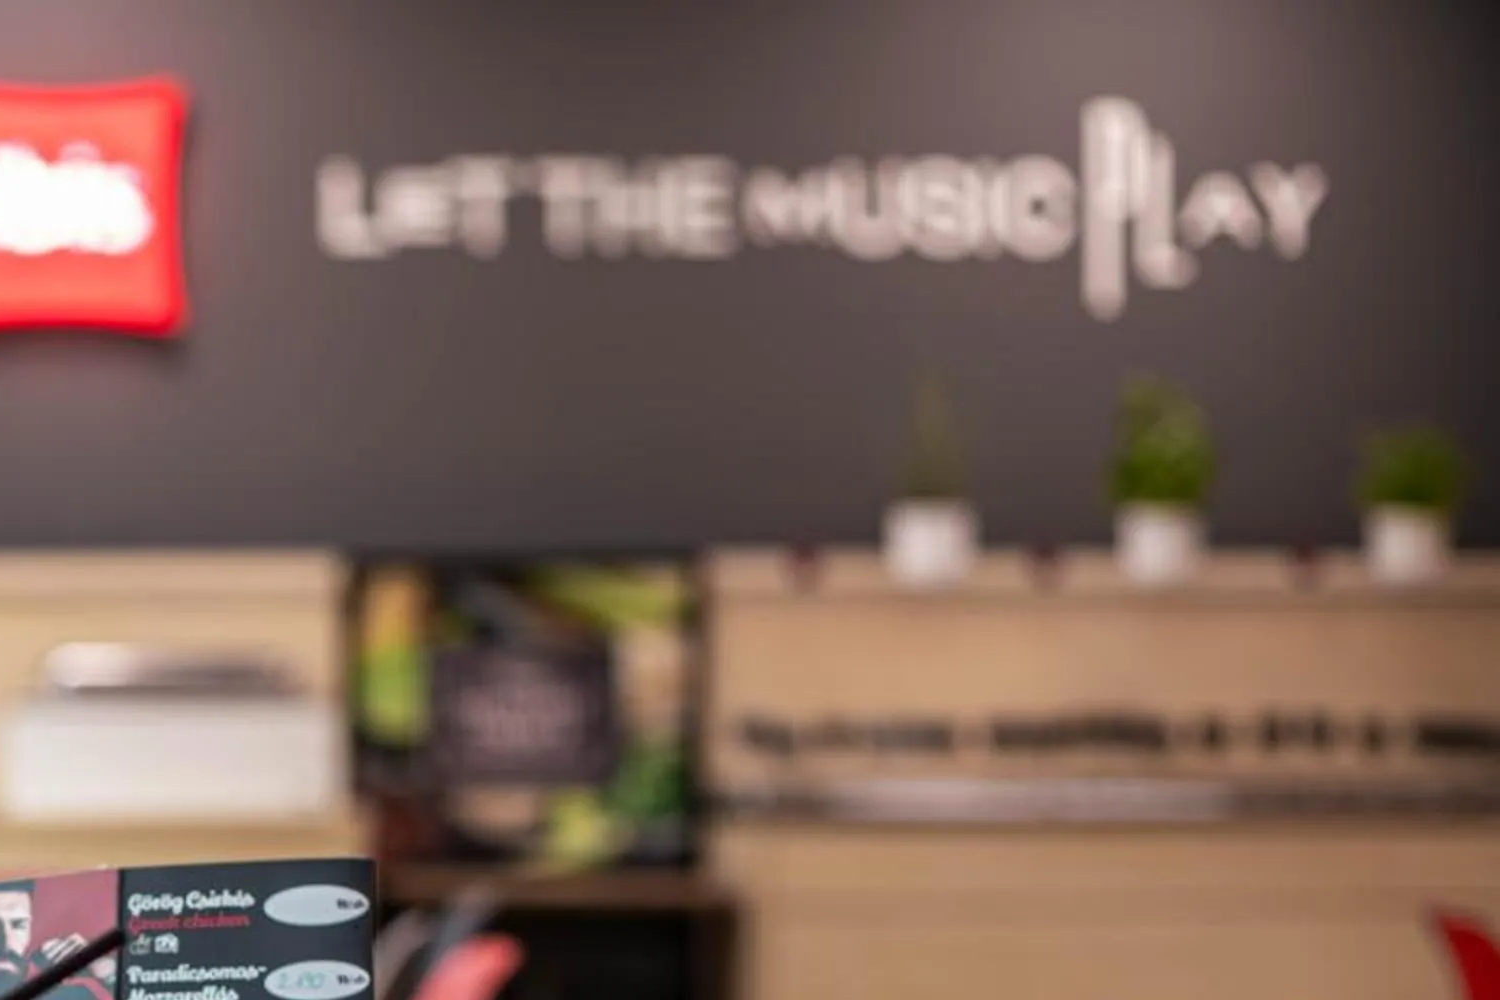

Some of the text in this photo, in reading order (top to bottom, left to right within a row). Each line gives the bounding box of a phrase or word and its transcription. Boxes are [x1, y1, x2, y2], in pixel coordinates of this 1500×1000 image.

[315, 95, 1329, 323] LET THE MUSIC PLAY
